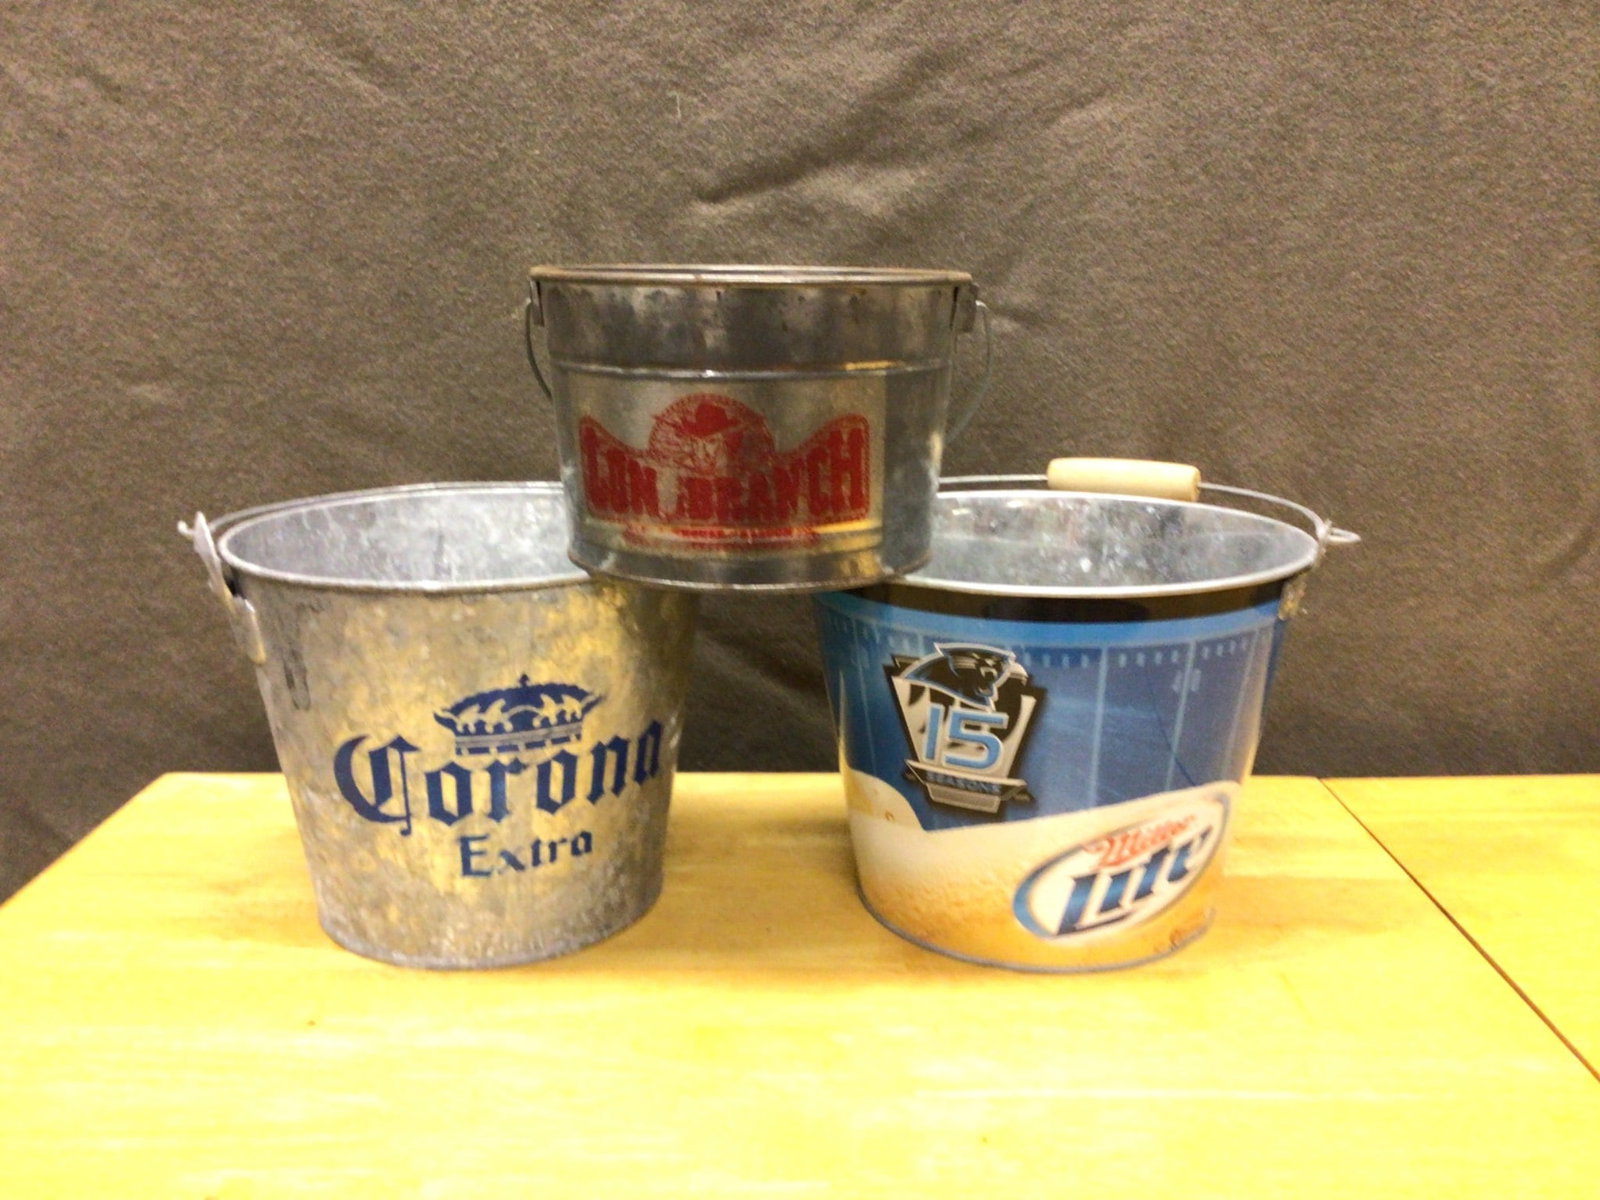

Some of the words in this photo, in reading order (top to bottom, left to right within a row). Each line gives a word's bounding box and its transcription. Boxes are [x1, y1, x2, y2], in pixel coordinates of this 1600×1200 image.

[923, 701, 1007, 772] 15
[334, 720, 662, 836] Corona
[458, 830, 593, 878] Extra
